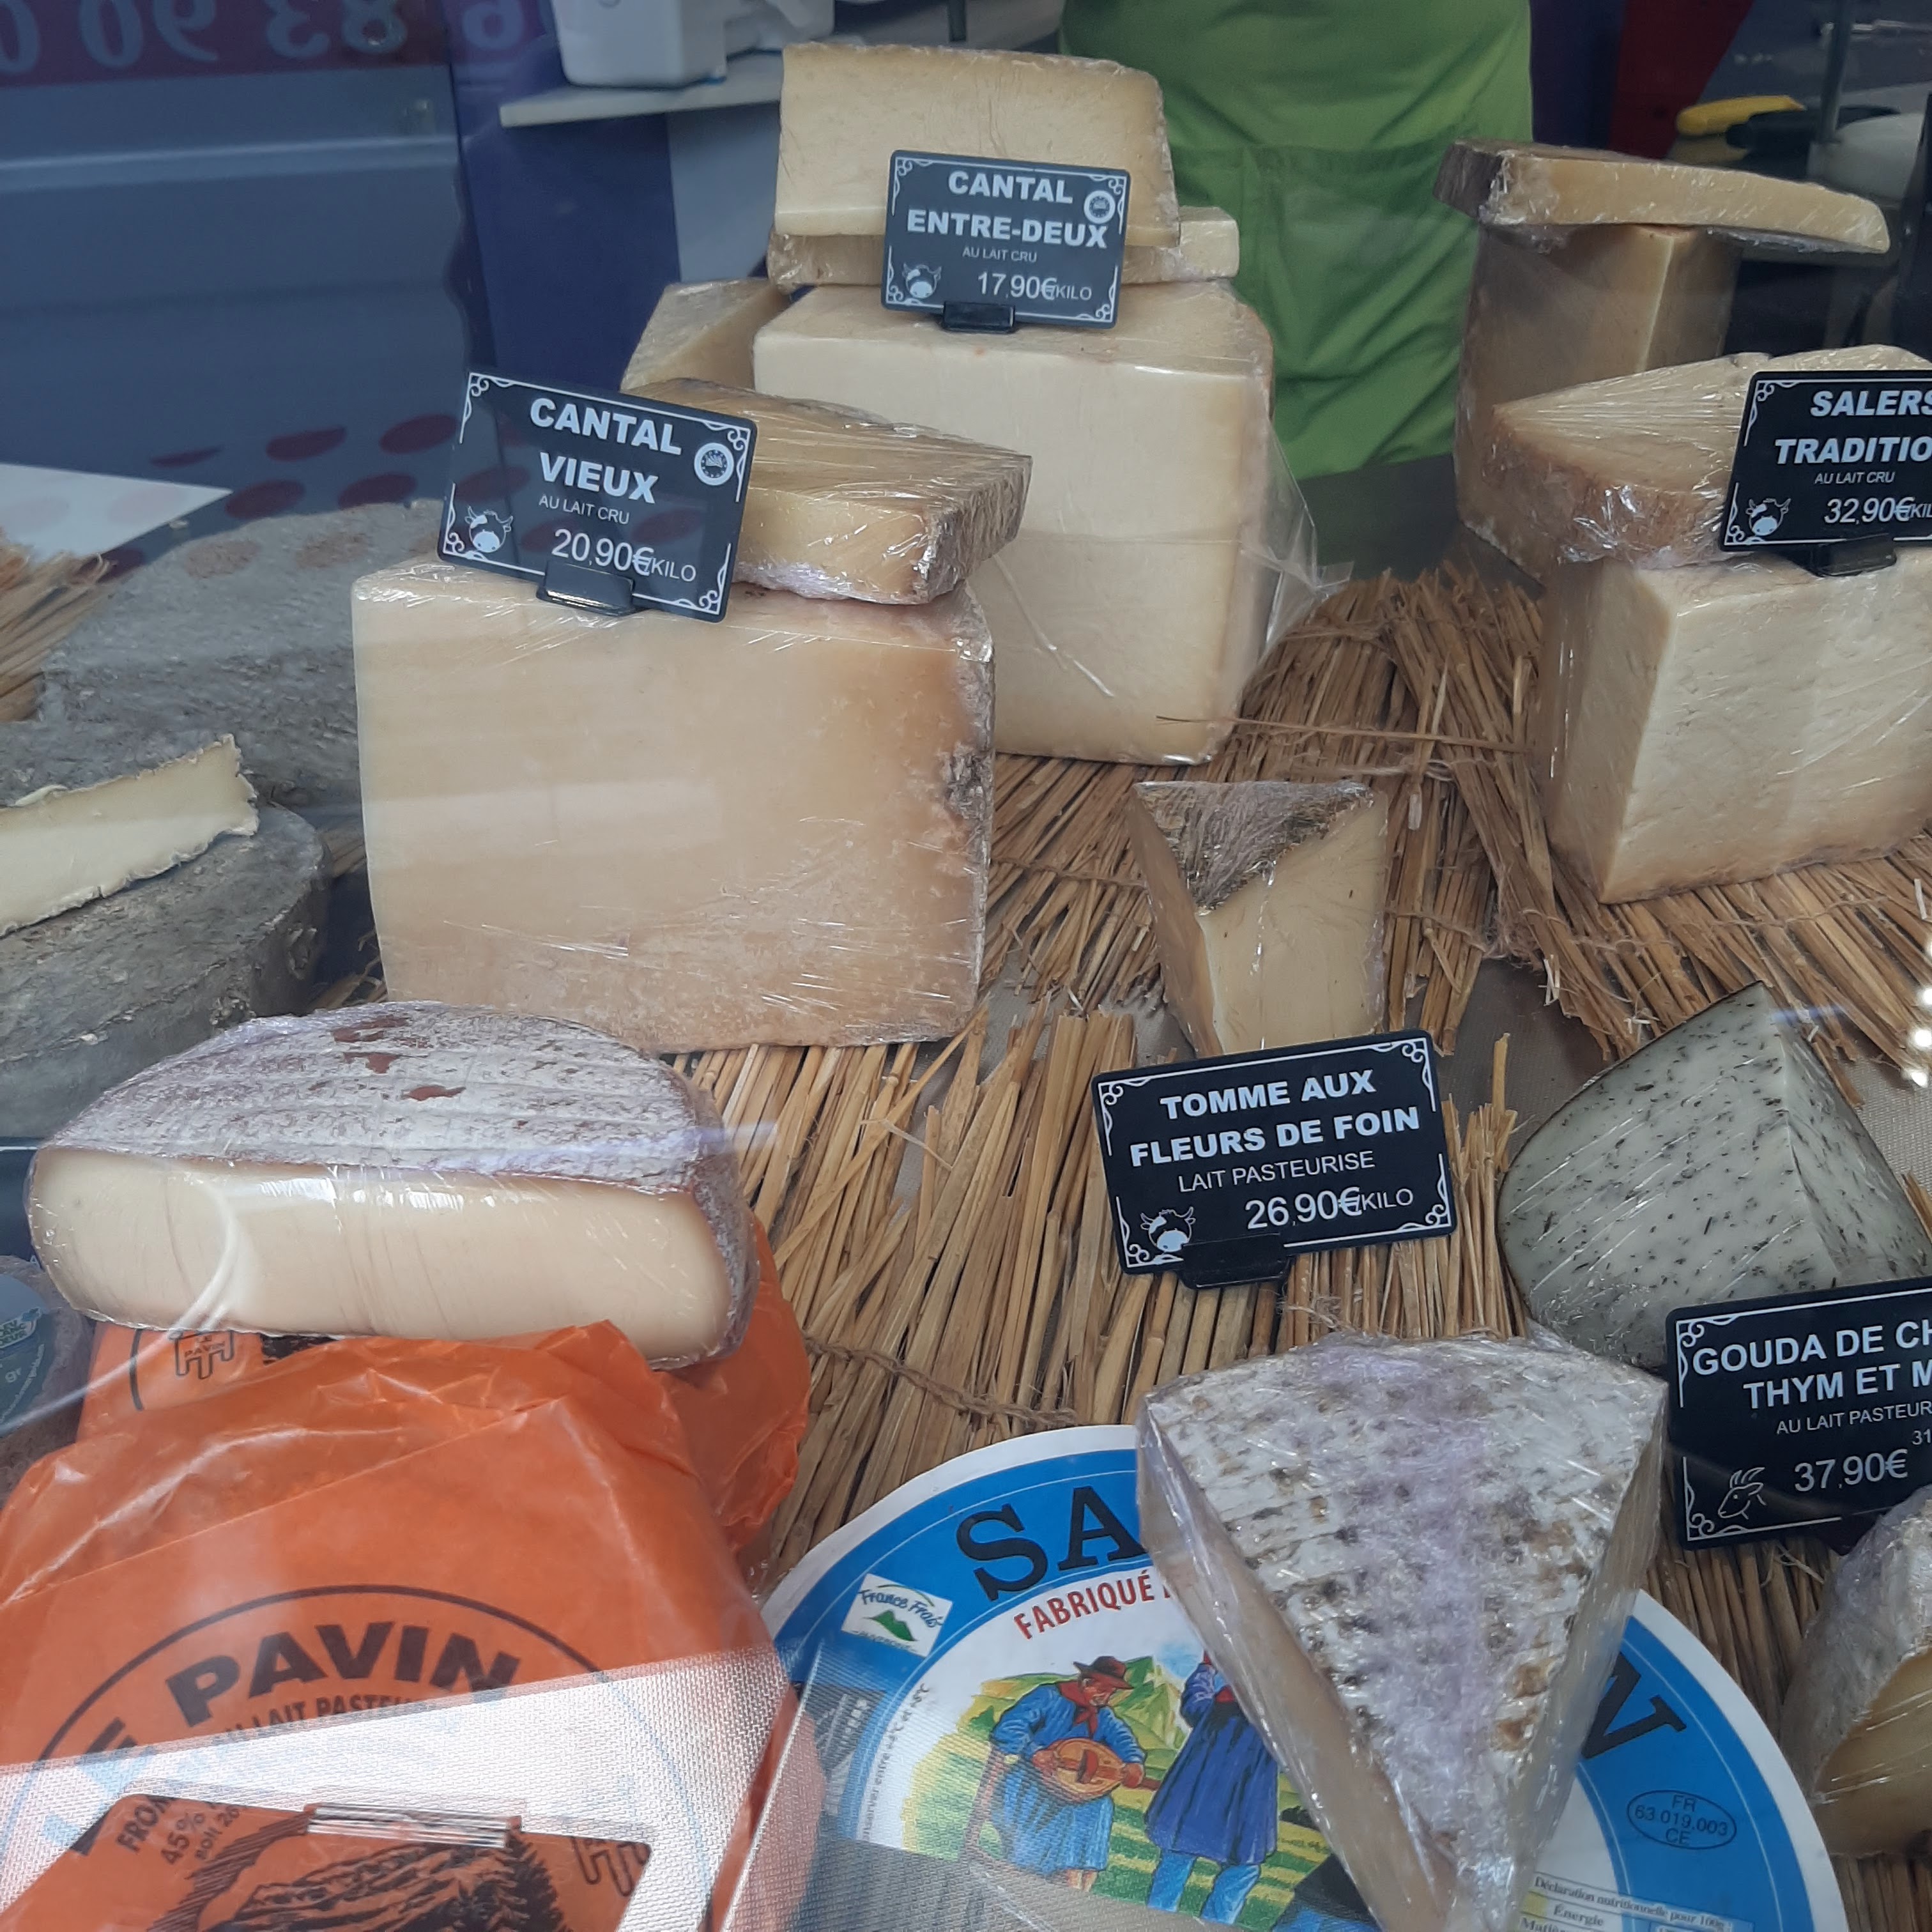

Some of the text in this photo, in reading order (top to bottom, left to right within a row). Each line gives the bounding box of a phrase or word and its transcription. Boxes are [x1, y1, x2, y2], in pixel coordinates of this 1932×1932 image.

[949, 171, 1073, 204] CANTAL
[907, 209, 1108, 249] ENTRE-DEUX
[962, 246, 1038, 263] AU LAIT CRU
[530, 398, 682, 455] CANTAL
[1775, 436, 1932, 464] TRADITIO
[539, 452, 659, 503] VIEUX
[1814, 471, 1896, 484] AU LAIT CRU
[539, 494, 630, 525] AU LAIT CRU
[1160, 1069, 1376, 1120] TOMME AUX
[1130, 1106, 1420, 1167] FLEURS DE FOIN
[1177, 1150, 1376, 1193] LAIT PASTEURISE
[1692, 1334, 1827, 1376] GOUDA
[1836, 1325, 1884, 1358] DE
[1743, 1371, 1844, 1409] THYM
[1856, 1363, 1901, 1395] ET
[1776, 1400, 1932, 1435] AU LAIT PASTEUR
[1794, 1448, 1908, 1492] 37,90€
[858, 1589, 908, 1609] France
[1014, 1569, 1155, 1639] FABRIQUÉ
[165, 1621, 521, 1728] PAVIN
[1673, 1795, 1696, 1813] FR
[161, 1811, 205, 1864] 45%
[1666, 1828, 1691, 1845] CE
[1535, 1876, 1595, 1902] Déclaration
[1553, 1903, 1604, 1928] Énergie
